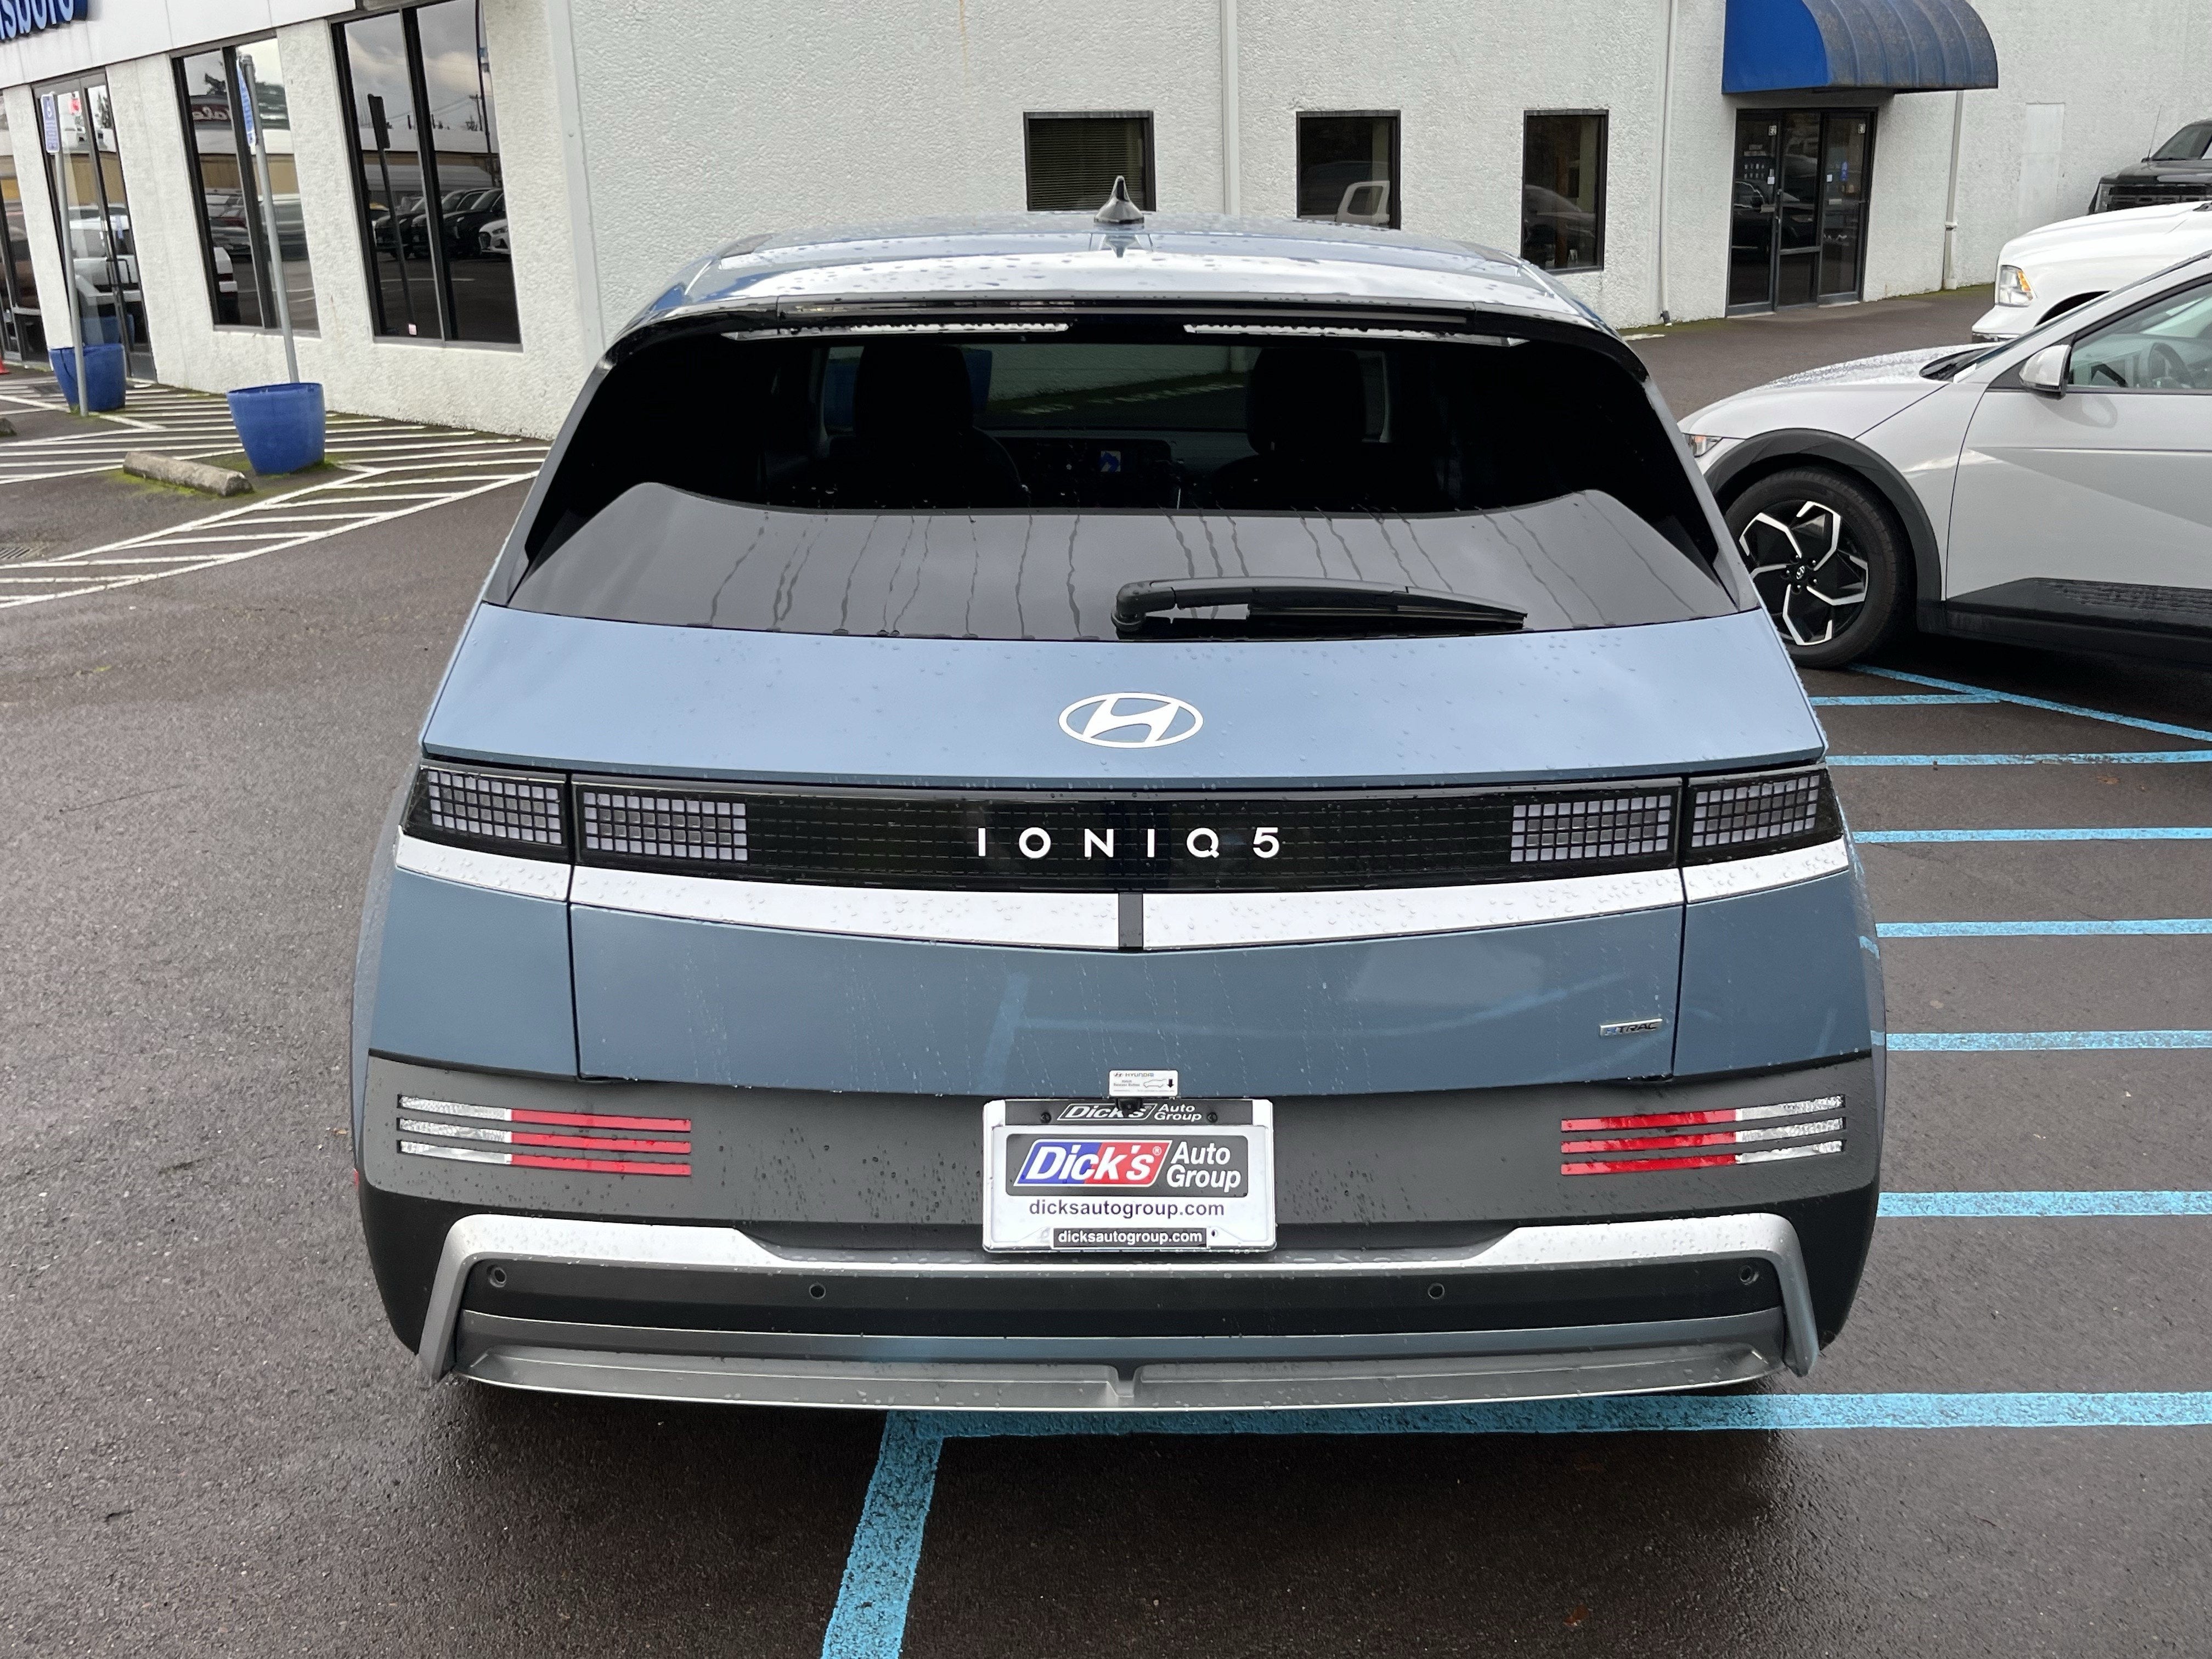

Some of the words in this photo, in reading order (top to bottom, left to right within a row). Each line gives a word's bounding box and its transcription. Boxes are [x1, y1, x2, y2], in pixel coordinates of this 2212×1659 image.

[978, 827, 1220, 859] IONIQ
[1252, 827, 1280, 858] 5
[1065, 1105, 1147, 1119] Dicks
[1154, 1112, 1202, 1122] Group
[1158, 1103, 1195, 1113] Auto
[1026, 1144, 1154, 1180] Dick's
[1171, 1141, 1231, 1165] Auto
[1166, 1164, 1242, 1193] Group
[1029, 1199, 1224, 1218] dicksautogroup.com
[1058, 1230, 1202, 1245] dicksautogroup.com
